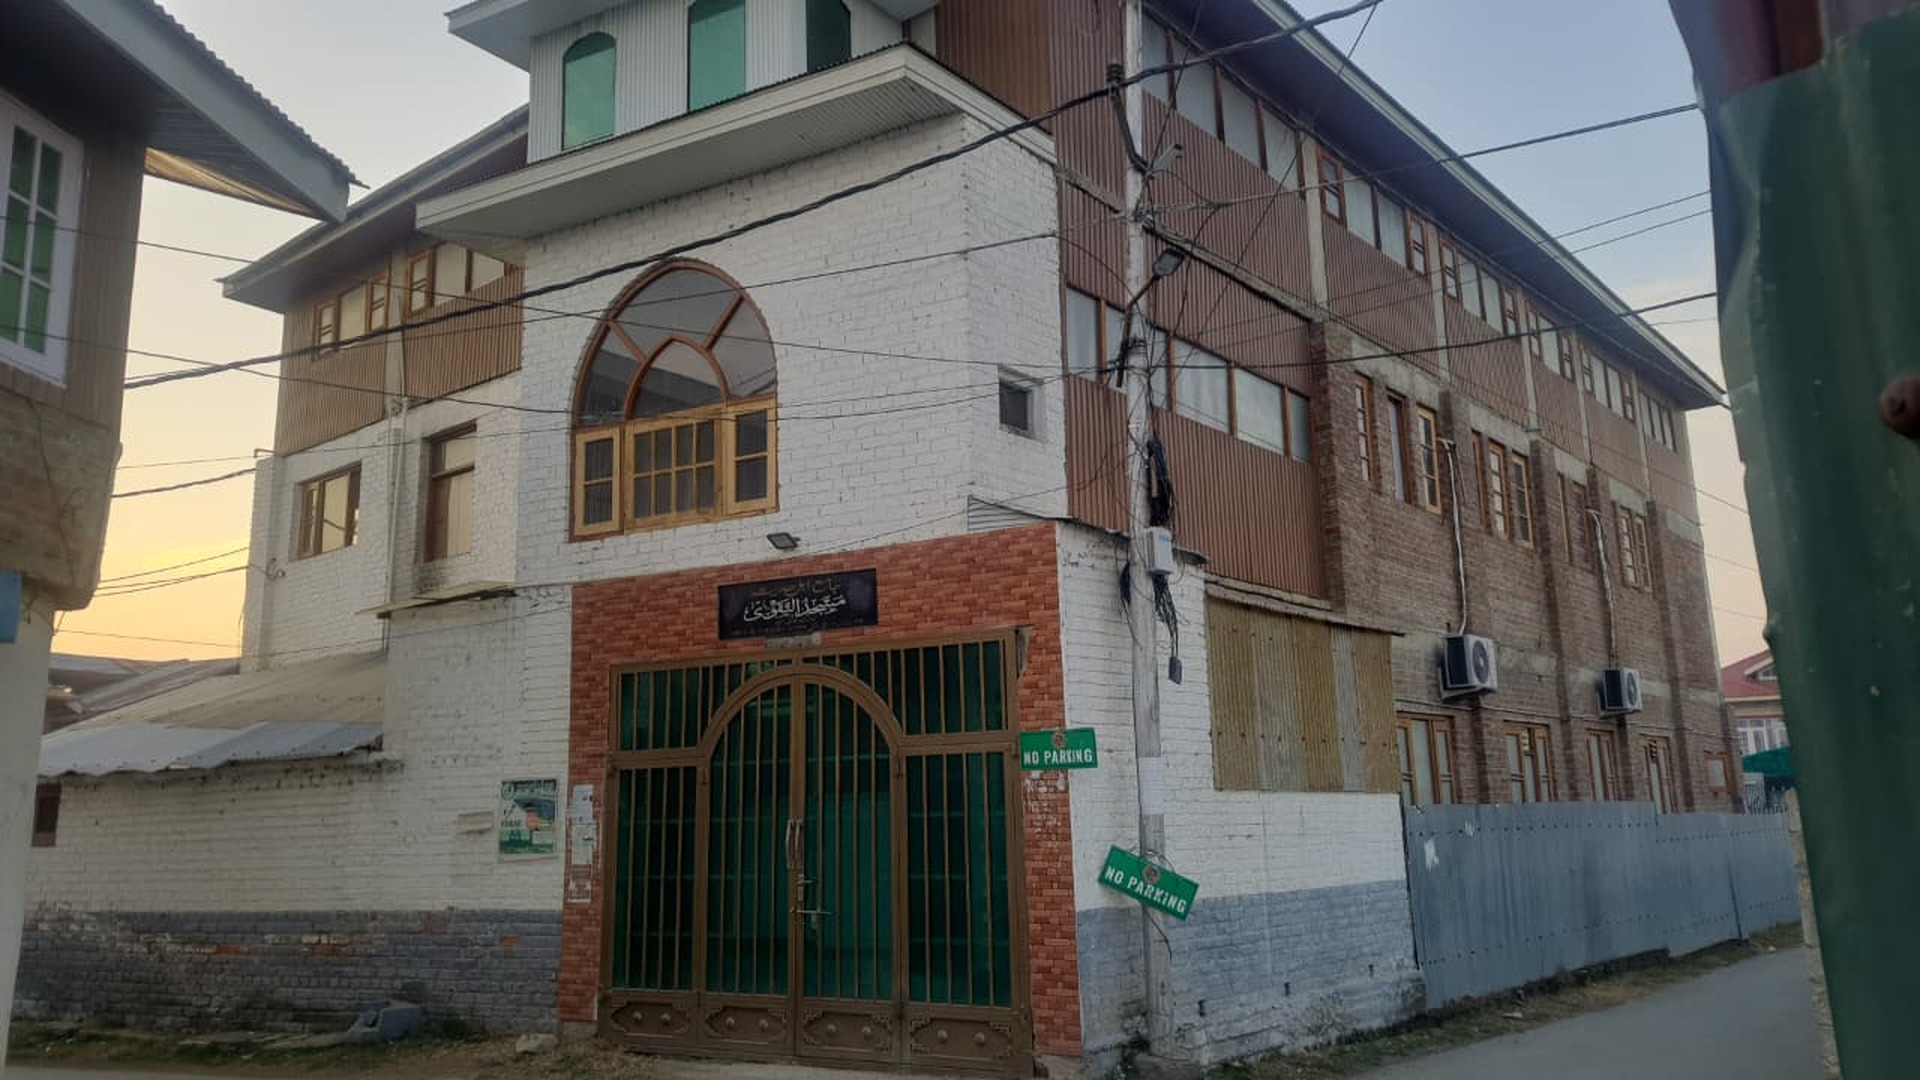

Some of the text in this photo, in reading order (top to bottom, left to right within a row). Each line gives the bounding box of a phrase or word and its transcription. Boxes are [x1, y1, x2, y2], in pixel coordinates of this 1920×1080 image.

[795, 595, 846, 617] مسجد
[1023, 748, 1093, 766] NO PARKING
[1104, 865, 1187, 914] NO PARKING
